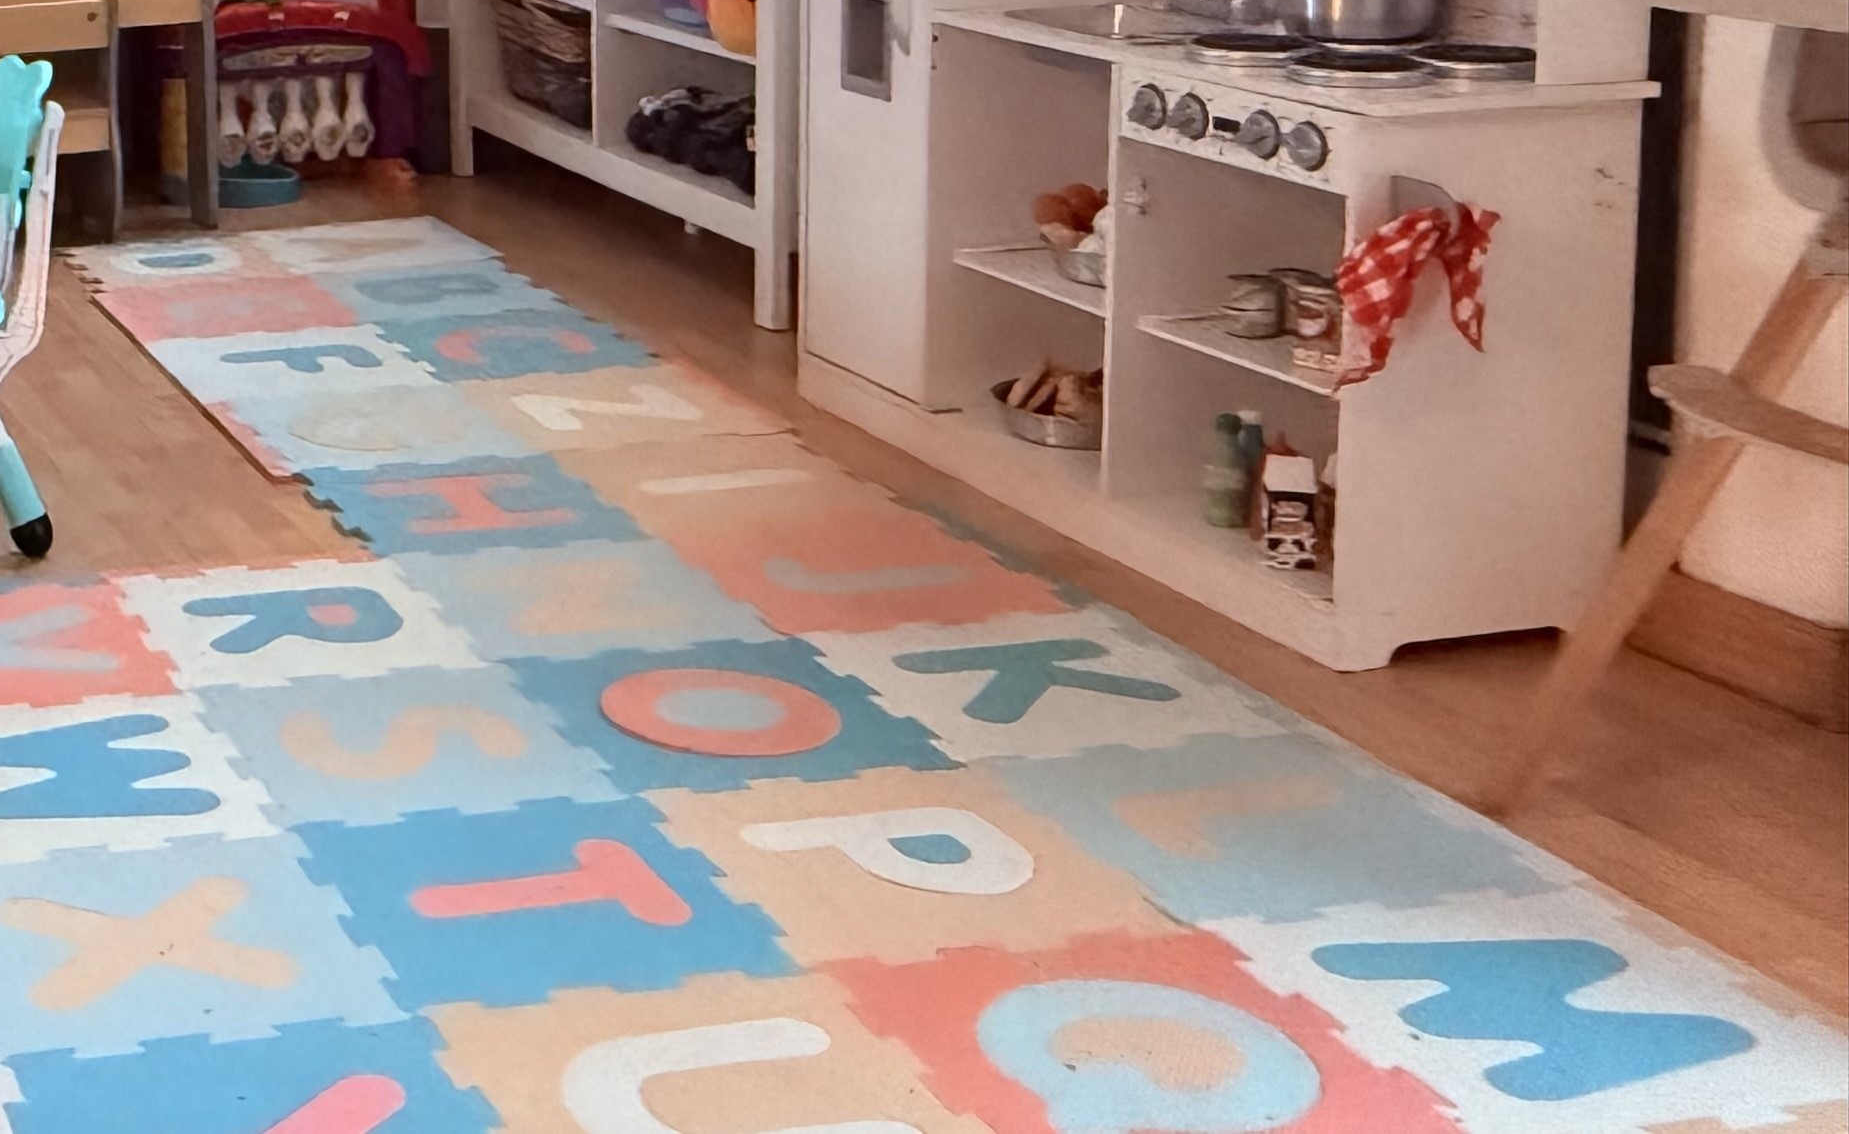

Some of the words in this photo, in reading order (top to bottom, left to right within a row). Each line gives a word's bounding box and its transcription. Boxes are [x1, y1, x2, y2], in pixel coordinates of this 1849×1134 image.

[220, 343, 383, 373] F
[434, 324, 598, 366] C
[365, 472, 578, 535] H
[182, 585, 403, 654] R
[600, 669, 842, 758] O
[892, 639, 1181, 723] K
[277, 704, 530, 782] S
[407, 839, 693, 926] T
[738, 806, 1035, 894] P
[1310, 939, 1756, 1101] M
